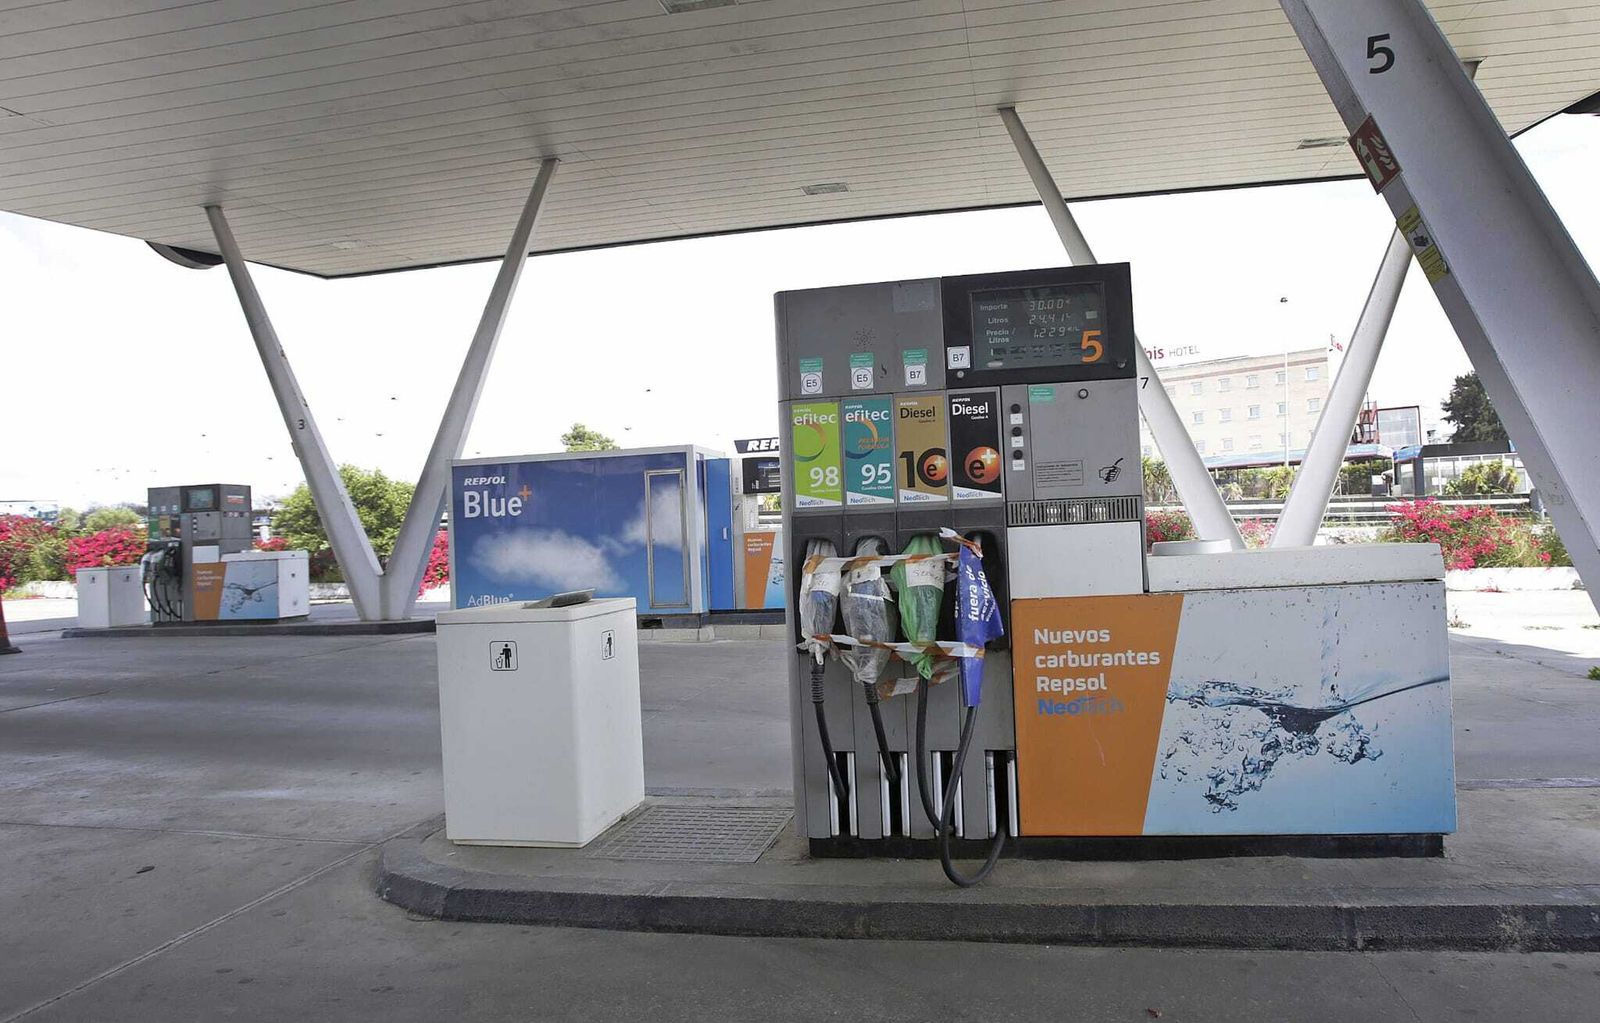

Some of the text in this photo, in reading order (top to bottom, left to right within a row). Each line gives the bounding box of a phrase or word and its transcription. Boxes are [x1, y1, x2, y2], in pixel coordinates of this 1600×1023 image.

[1367, 33, 1395, 74] 5
[980, 303, 1008, 312] Importe
[987, 317, 1008, 325] Litros
[986, 328, 1009, 337] Precio
[988, 337, 1009, 345] Litros
[1081, 329, 1104, 363] 5
[952, 353, 965, 362] B7
[1169, 345, 1200, 357] HOTEL
[856, 375, 869, 383] E5
[909, 370, 921, 379] B7
[806, 379, 818, 388] E5
[1140, 377, 1149, 390] 7
[845, 409, 890, 422] efitec
[900, 406, 936, 419] Diesel
[952, 402, 989, 416] Diesel
[298, 418, 305, 430] 3
[793, 413, 837, 426] efitec
[809, 466, 839, 488] 98
[861, 463, 892, 485] 95
[464, 476, 507, 486] REPSOL
[965, 564, 979, 621] fuera de
[1034, 628, 1111, 645] Nuevos
[1035, 650, 1161, 669] carburantes
[1036, 673, 1108, 696] Repsol
